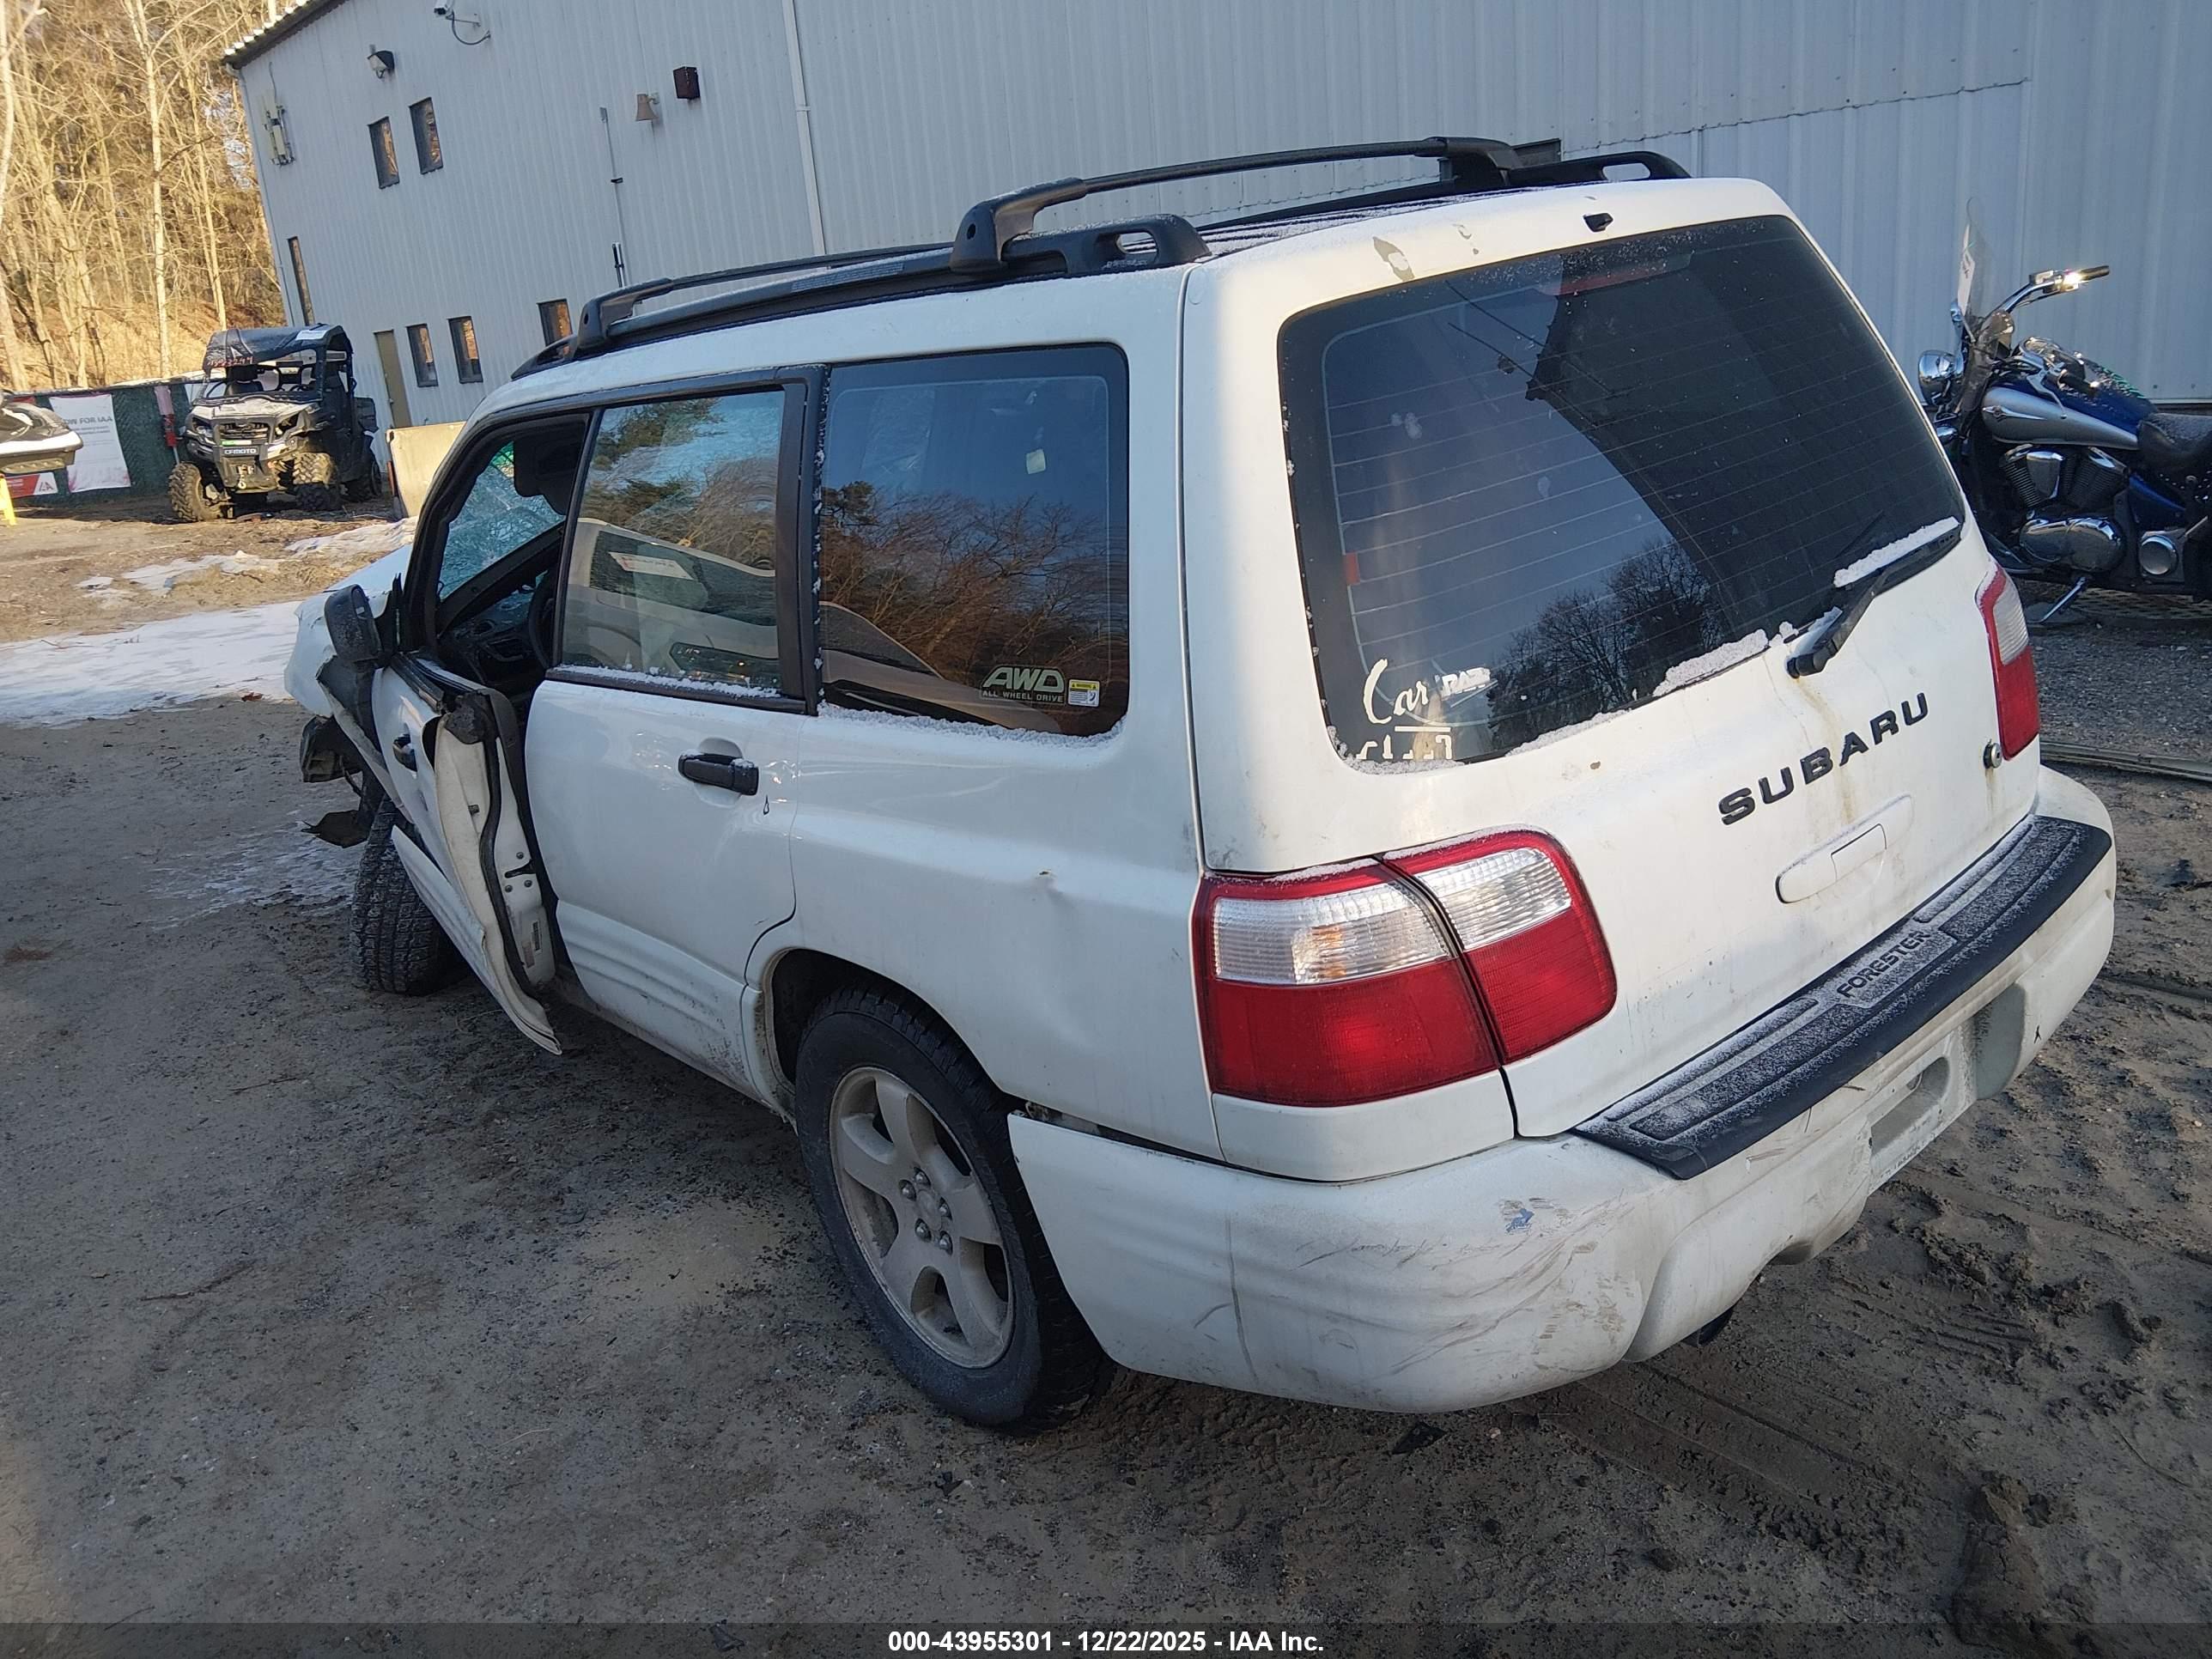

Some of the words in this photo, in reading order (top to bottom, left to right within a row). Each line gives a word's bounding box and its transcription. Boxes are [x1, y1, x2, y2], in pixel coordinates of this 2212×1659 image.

[982, 666, 1065, 693] AWD
[1002, 692, 1032, 701] WHEEL
[1036, 694, 1064, 703] DRIVE
[1718, 692, 1929, 825] SUBARU
[1836, 930, 1931, 999] FORESTER
